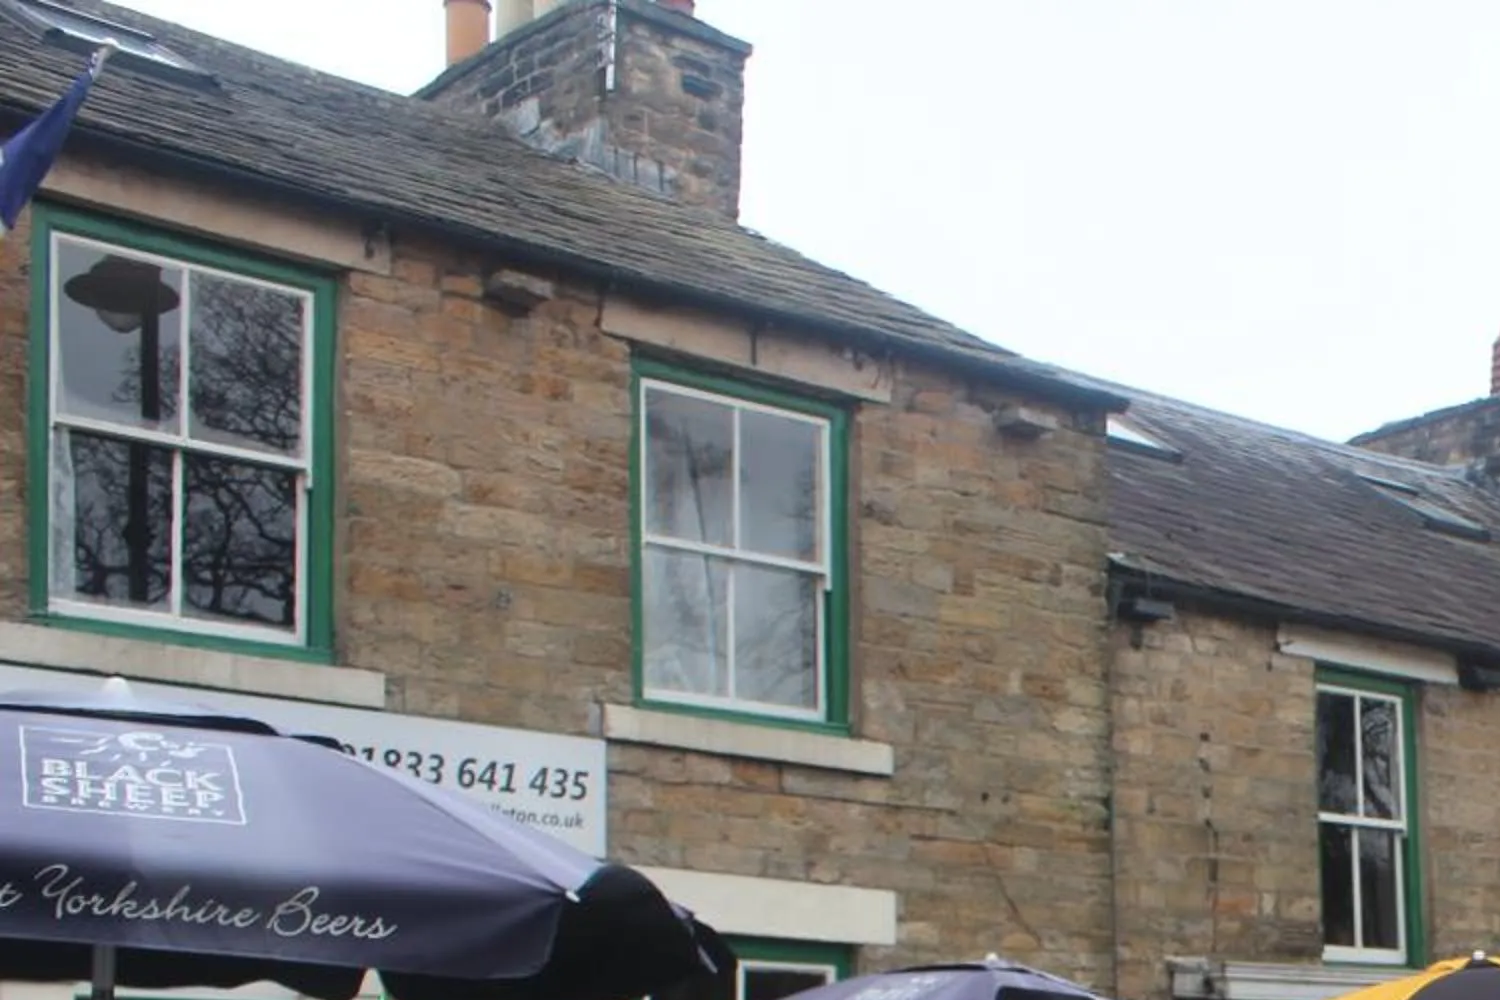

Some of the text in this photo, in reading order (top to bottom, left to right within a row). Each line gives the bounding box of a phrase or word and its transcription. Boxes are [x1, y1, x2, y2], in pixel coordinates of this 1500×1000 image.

[41, 758, 221, 792] BLACK
[41, 777, 224, 808] SHEEP
[457, 758, 516, 793] 641
[529, 767, 588, 800] 435
[34, 864, 260, 928] Yorkshire
[267, 886, 397, 939] Beers
